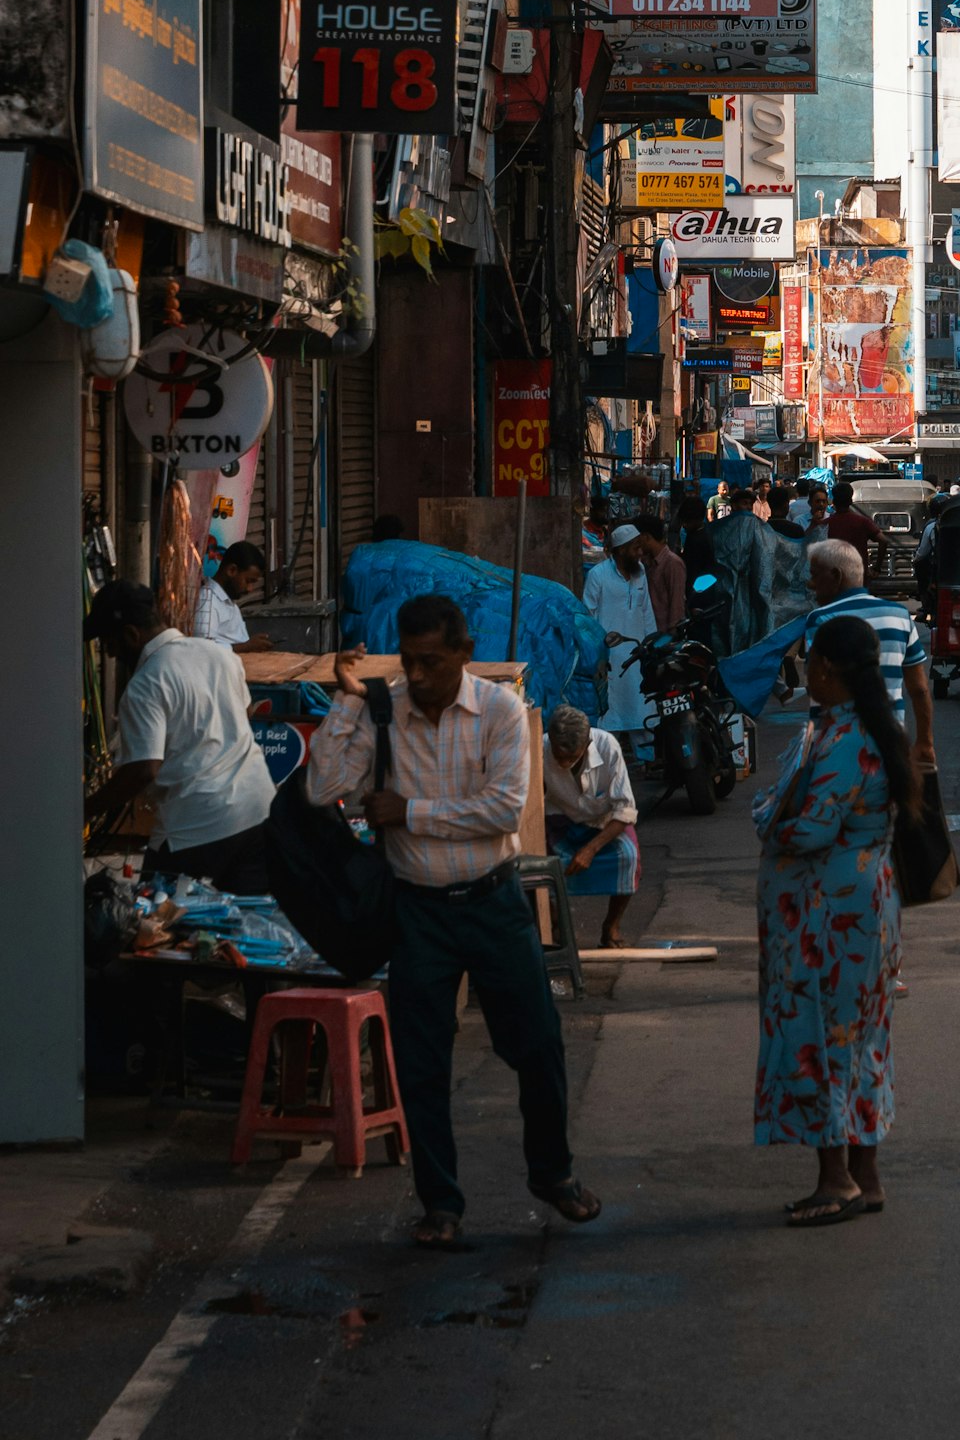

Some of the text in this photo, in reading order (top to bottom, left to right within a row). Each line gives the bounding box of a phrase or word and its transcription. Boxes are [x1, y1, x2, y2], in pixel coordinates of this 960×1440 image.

[316, 3, 442, 32] HOUSE
[724, 18, 771, 33] (PVT)
[776, 20, 808, 31] LTD
[316, 31, 442, 44] CREATIVE RADIANCE
[313, 46, 438, 112] 118
[641, 174, 720, 188] 0777 467 574
[701, 236, 781, 244] DAHUA TECHNOLOGY
[732, 267, 770, 279] Mobile
[151, 434, 242, 454] BIXTON
[266, 730, 288, 740] Red
